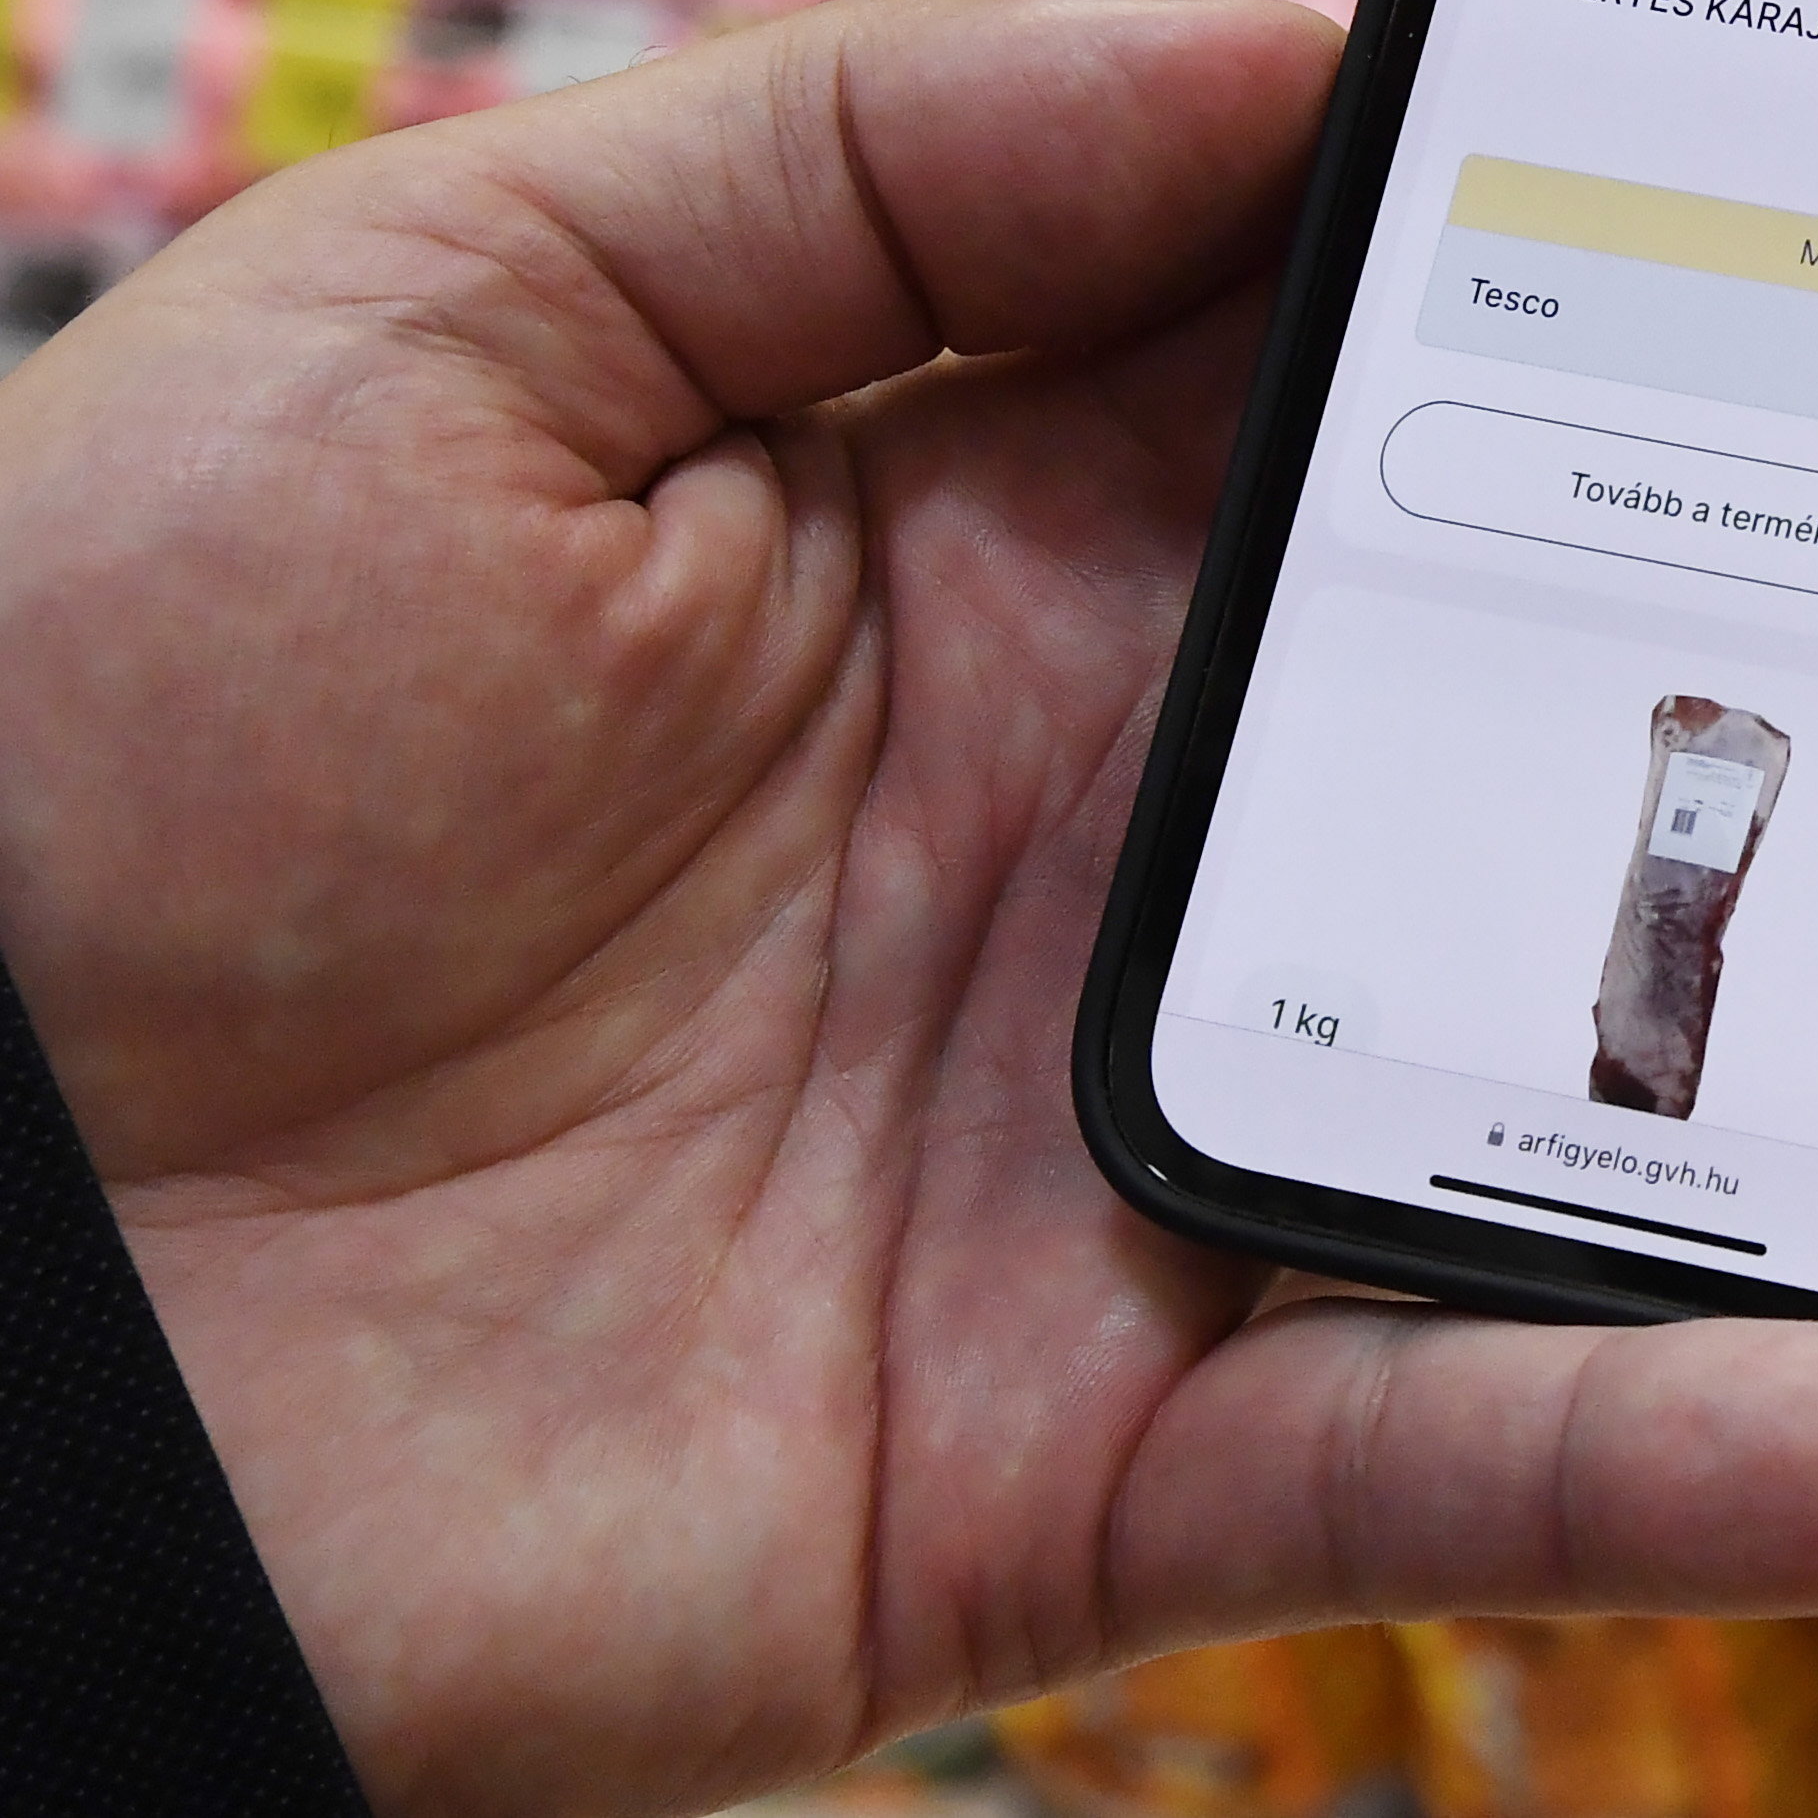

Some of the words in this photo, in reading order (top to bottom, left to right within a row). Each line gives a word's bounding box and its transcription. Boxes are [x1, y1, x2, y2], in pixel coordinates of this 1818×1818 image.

[1470, 277, 1559, 318] Tesco
[1571, 471, 1683, 518] Tovább
[1691, 502, 1710, 524] a
[1294, 1003, 1340, 1048] kg
[1518, 1133, 1740, 1196] arfigyelo.gvh.hu
